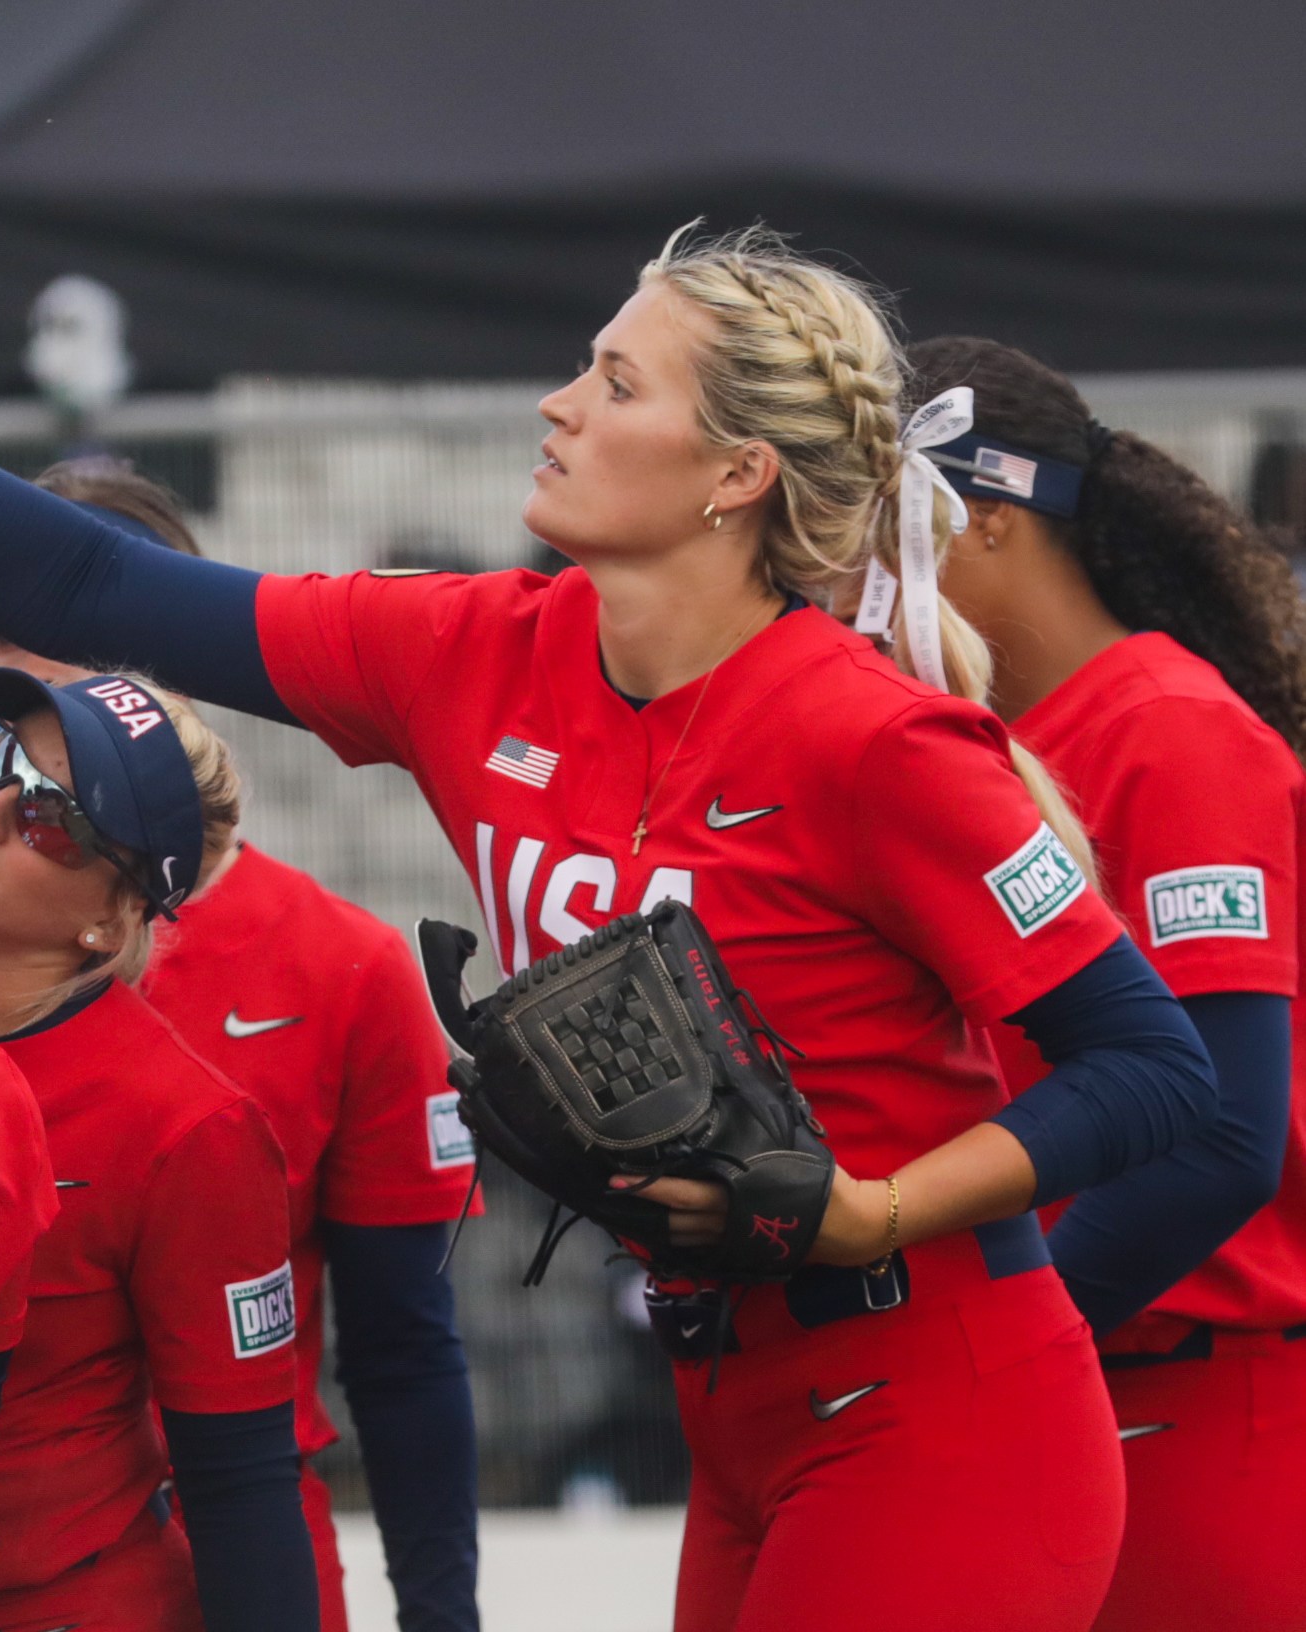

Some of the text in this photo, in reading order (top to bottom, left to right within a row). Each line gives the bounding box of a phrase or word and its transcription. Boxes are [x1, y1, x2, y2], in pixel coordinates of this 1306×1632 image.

[85, 679, 164, 739] USA
[1024, 886, 1068, 923] SPORTING
[1155, 880, 1257, 926] DICK'S
[686, 948, 721, 1013] Tana
[231, 1285, 259, 1297] EVERY
